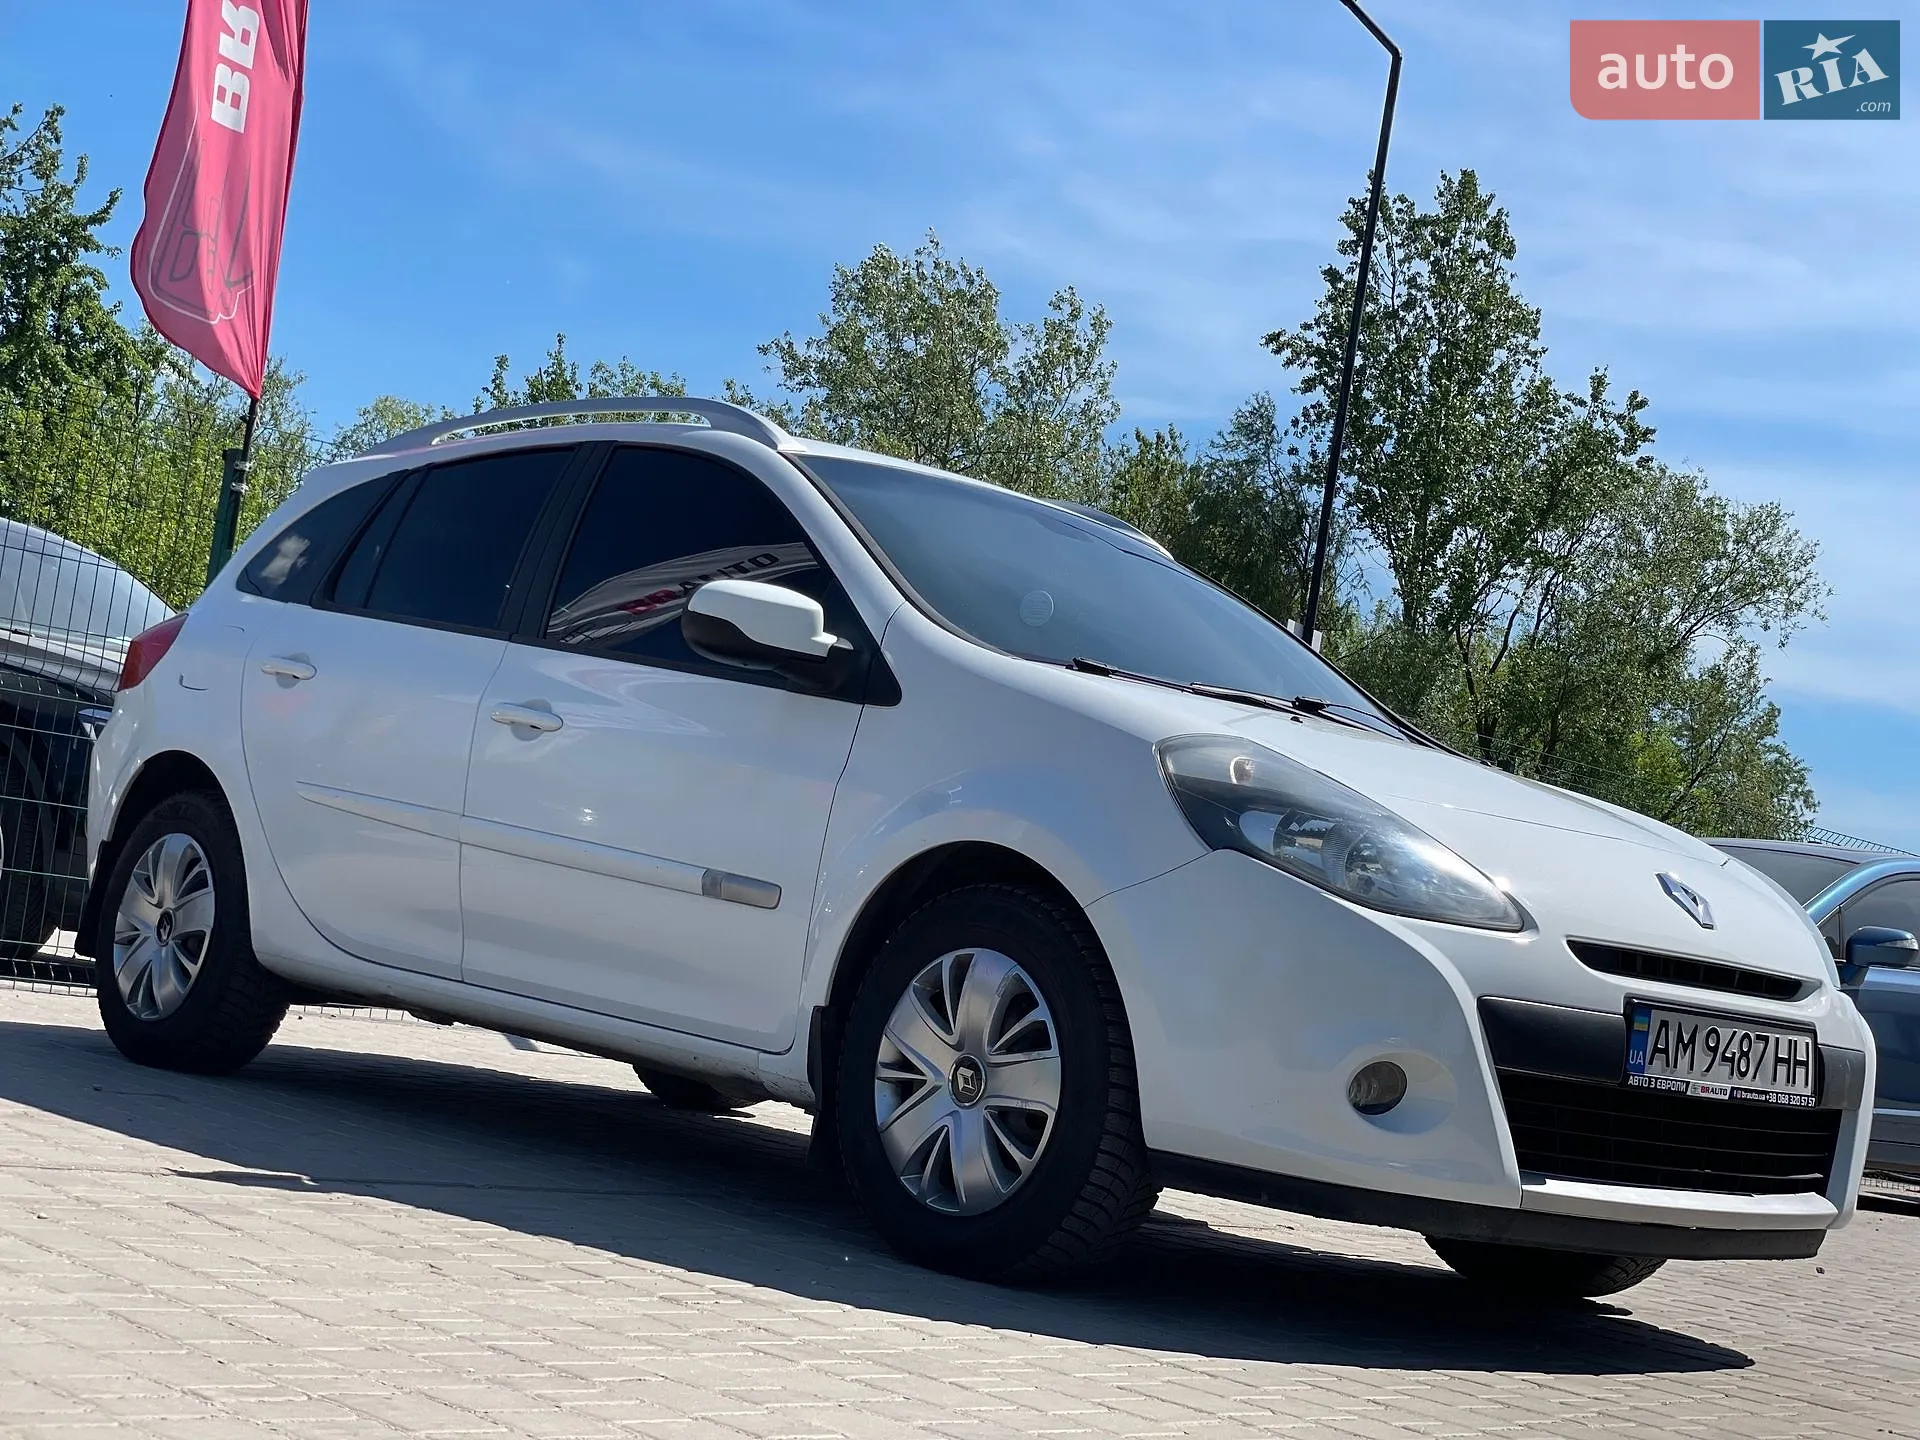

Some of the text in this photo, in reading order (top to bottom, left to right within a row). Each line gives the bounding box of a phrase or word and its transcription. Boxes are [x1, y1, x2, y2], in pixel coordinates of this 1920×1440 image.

[1629, 1050, 1644, 1066] UA
[1648, 1019, 1810, 1087] AM 9487 HH
[1628, 1075, 1648, 1087] АВТО
[1700, 1085, 1728, 1096] BRAUTO
[1778, 1094, 1789, 1104] 068
[1789, 1095, 1800, 1105] 320
